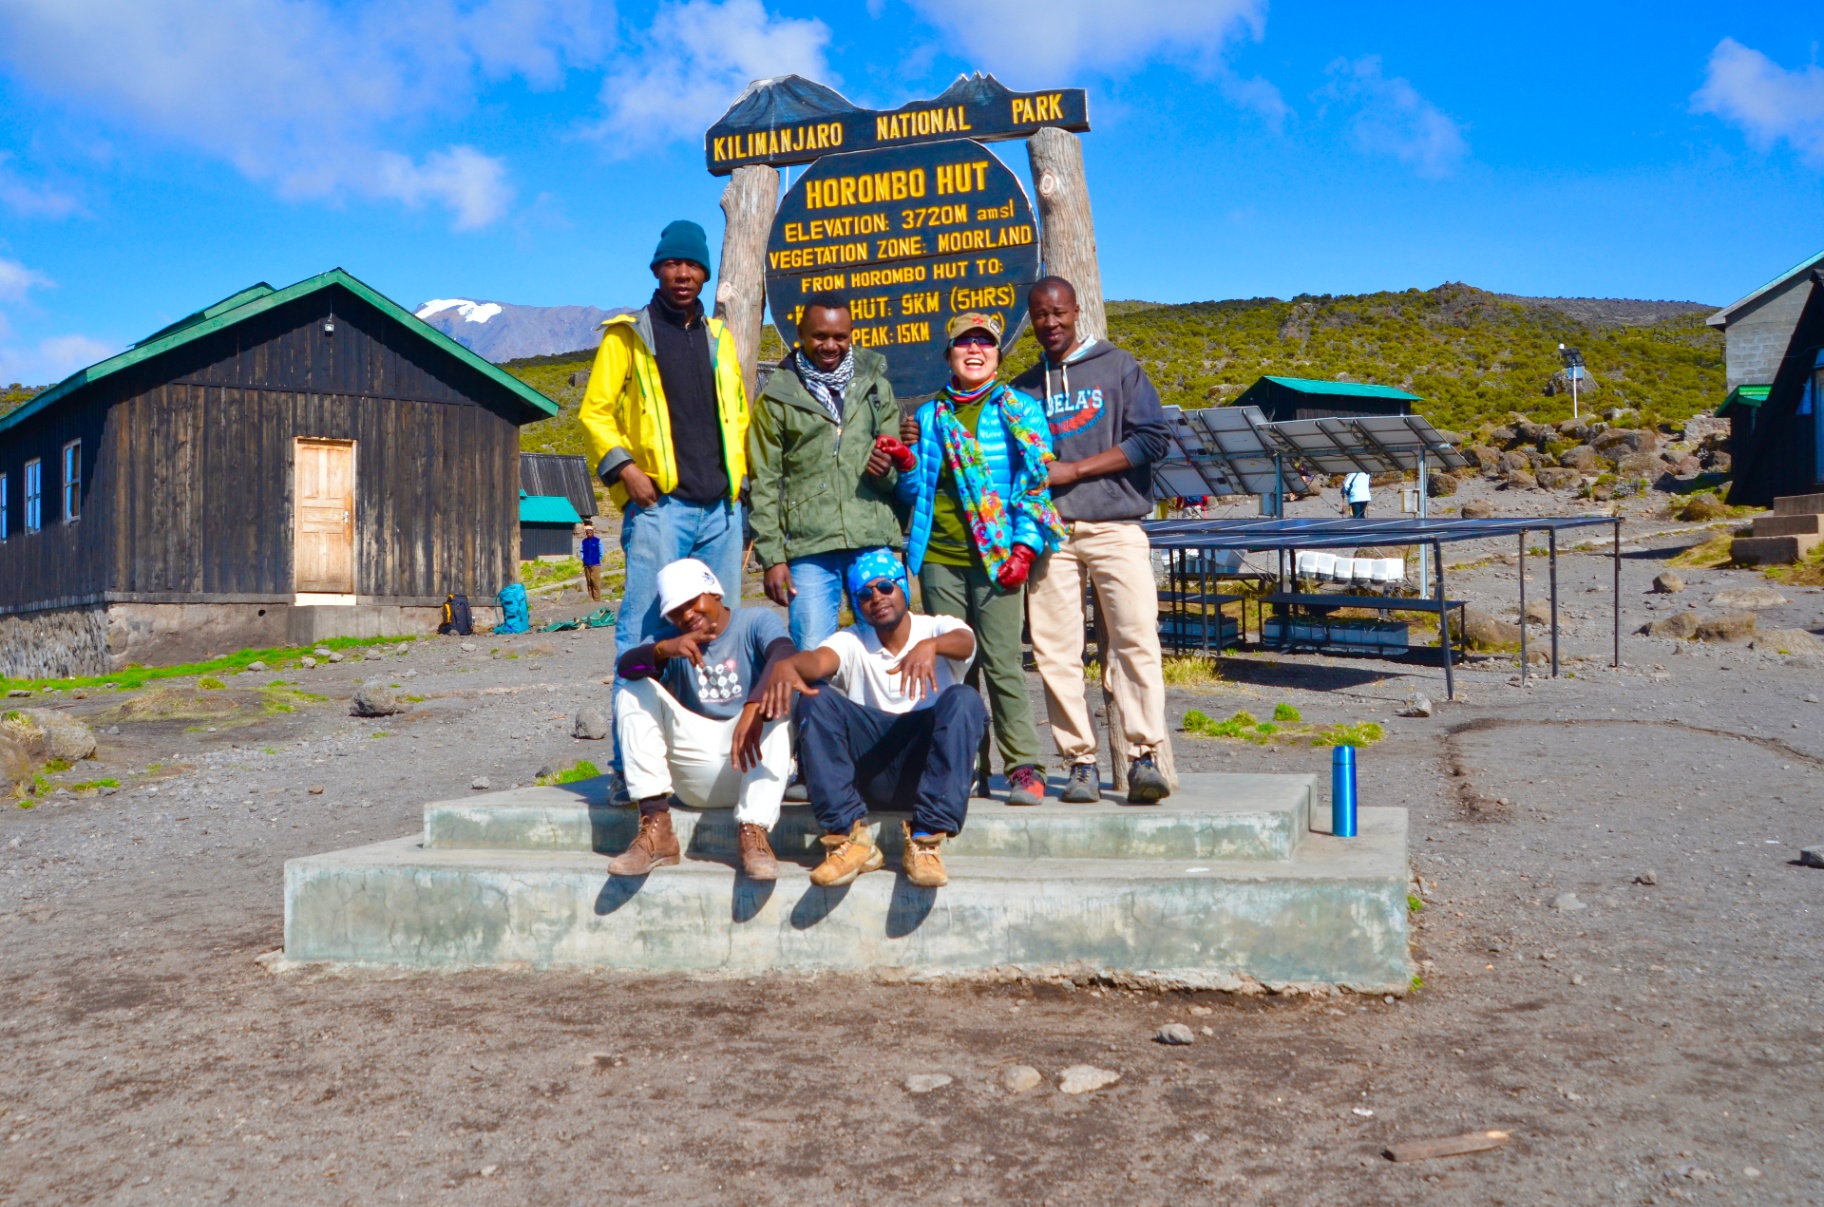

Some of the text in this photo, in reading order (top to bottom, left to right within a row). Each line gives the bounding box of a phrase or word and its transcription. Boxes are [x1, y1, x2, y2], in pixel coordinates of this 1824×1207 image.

[714, 93, 1064, 162] KILIMANJARO NATIONAL PARK
[806, 161, 988, 209] HOROMBO HUT
[785, 198, 1015, 243] ELEVATION: 3720M amsl
[769, 225, 1032, 270] VEGETATION ZONE: MOORLAND
[802, 257, 1004, 294] FROM HOROMBO HUT TO:
[849, 282, 1015, 321] HUT: 9KM (5HRS)
[851, 325, 895, 348] PEAK:
[896, 321, 930, 344] 15KM
